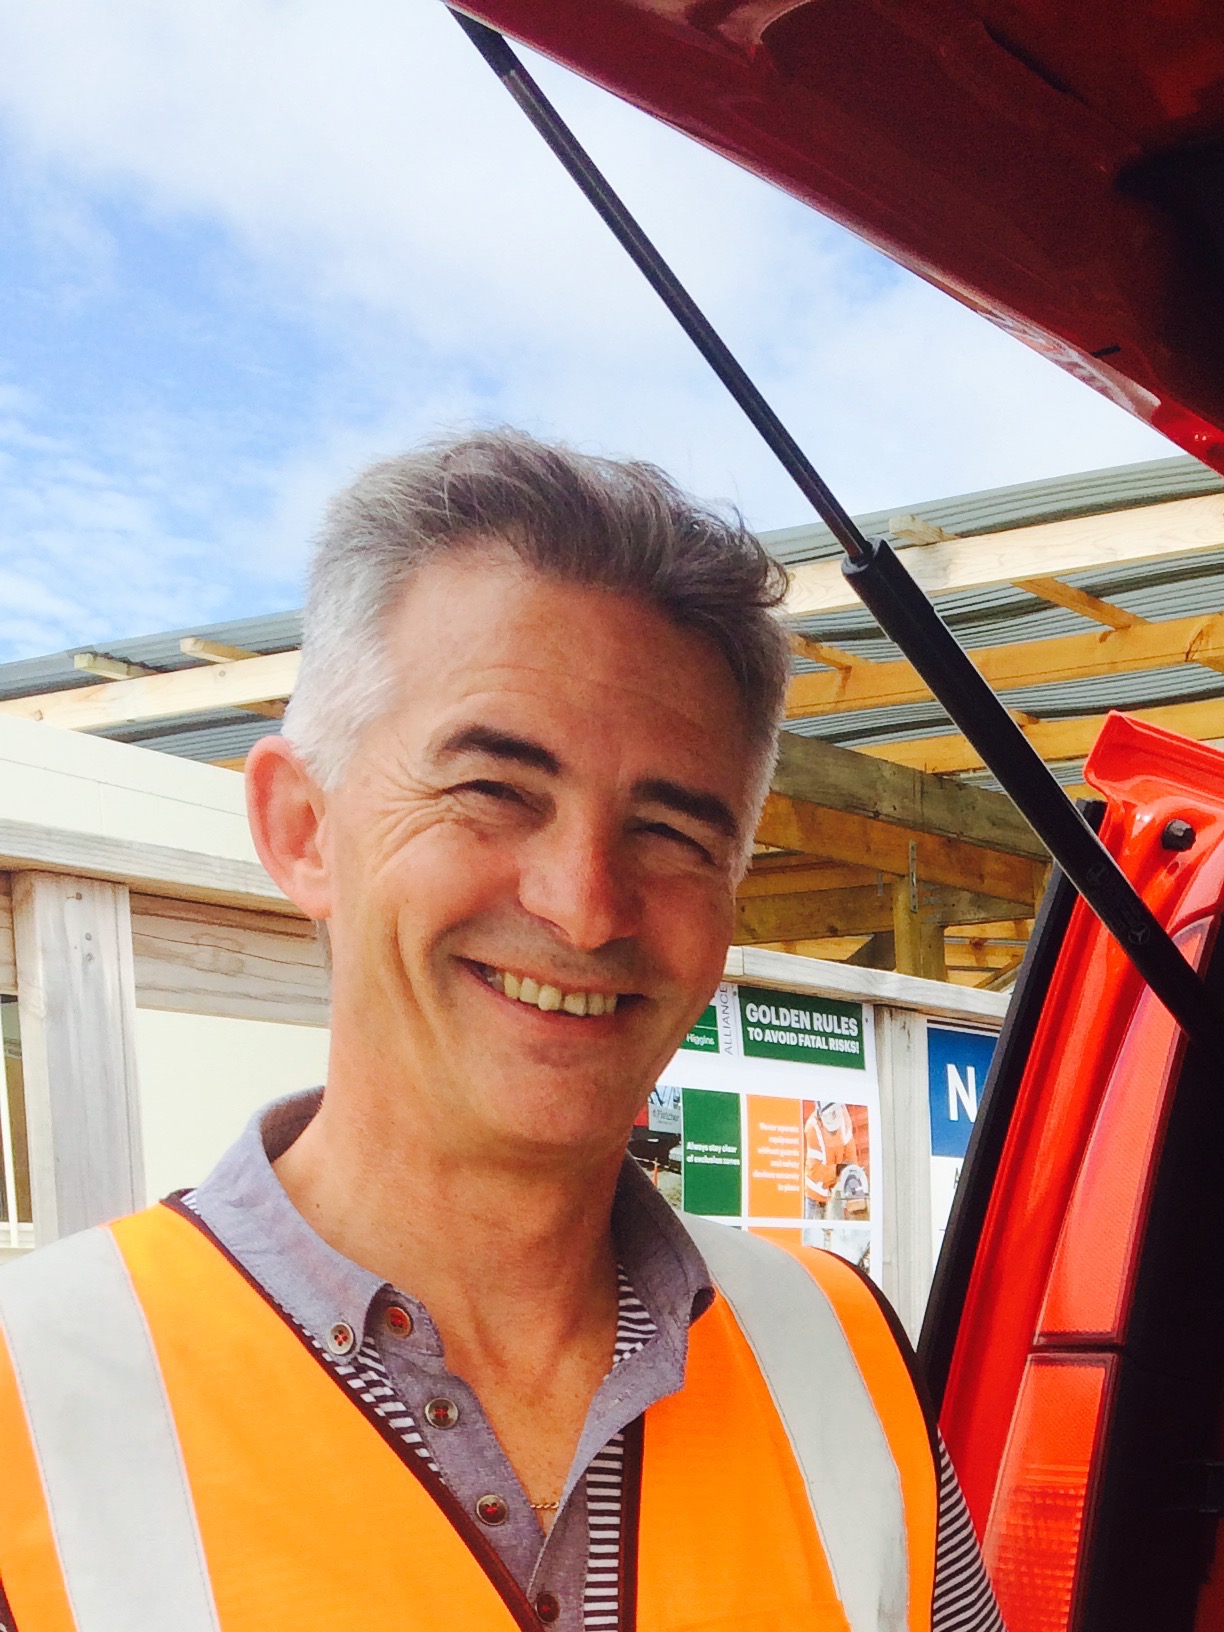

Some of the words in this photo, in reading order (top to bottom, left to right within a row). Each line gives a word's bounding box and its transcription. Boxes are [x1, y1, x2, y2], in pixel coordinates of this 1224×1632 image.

[746, 1004, 812, 1030] GOLDEN
[813, 1012, 858, 1037] RULES
[686, 1033, 715, 1047] Higgins
[747, 1027, 764, 1041] TO
[764, 1031, 797, 1046] AVOID
[798, 1034, 828, 1050] FATAL
[829, 1039, 860, 1055] RISKS!
